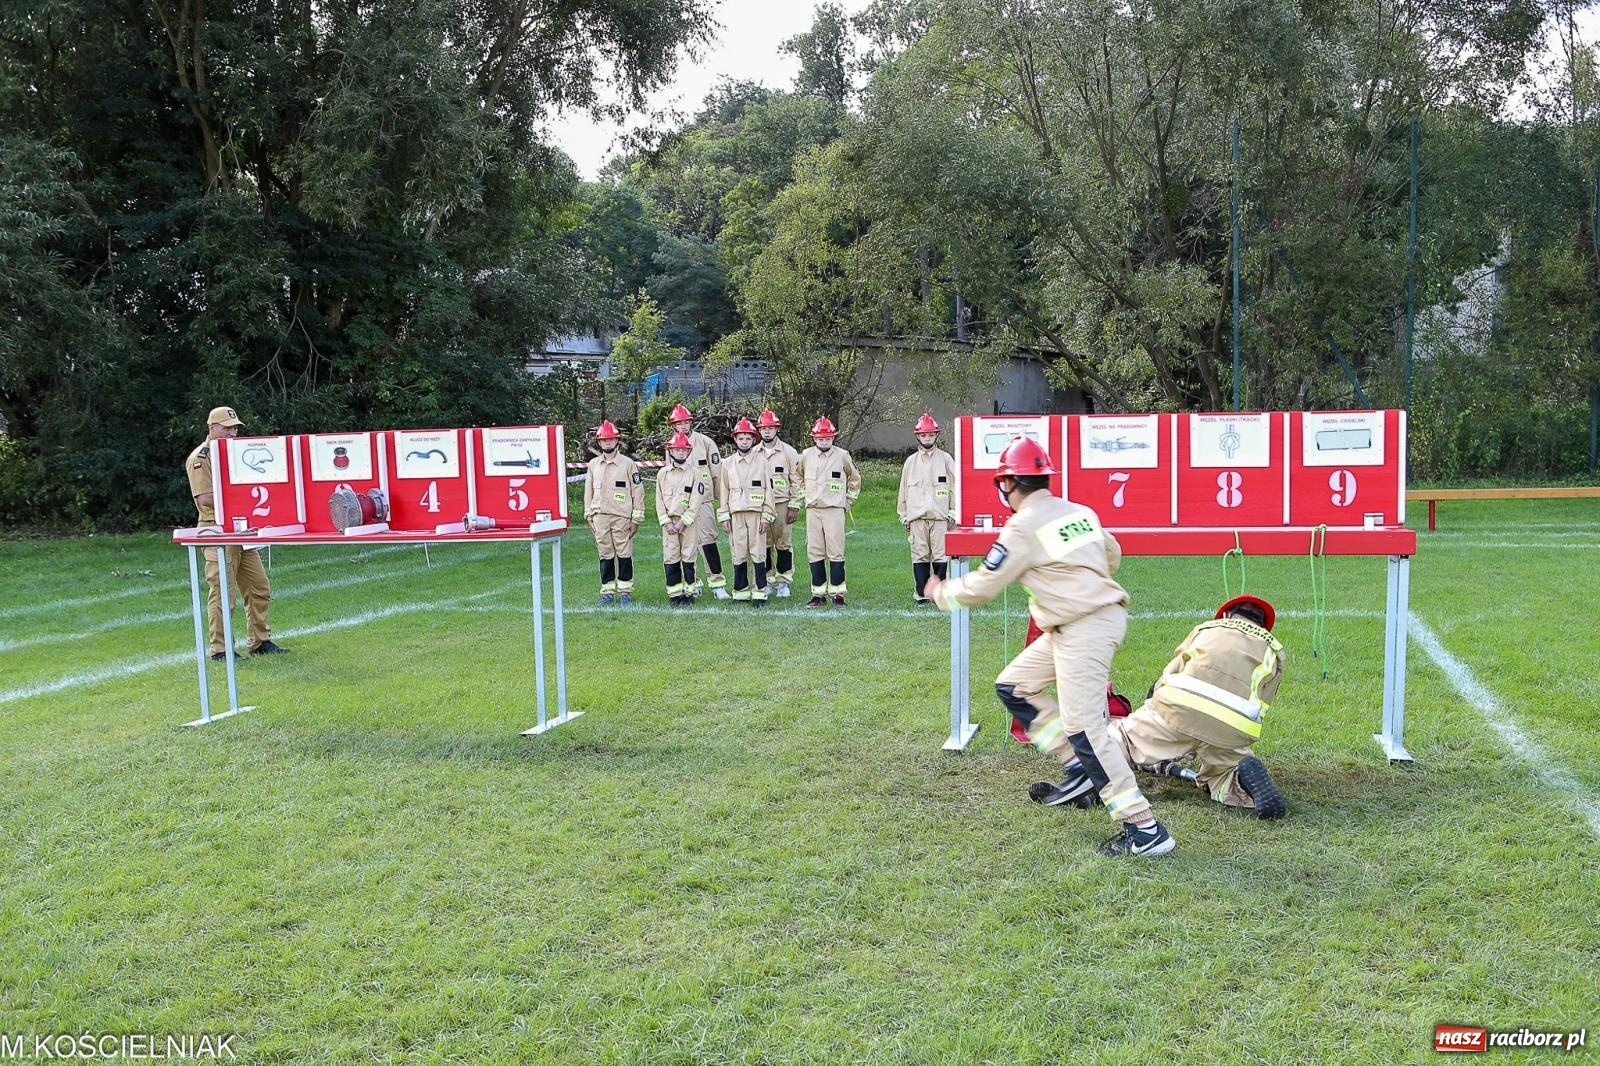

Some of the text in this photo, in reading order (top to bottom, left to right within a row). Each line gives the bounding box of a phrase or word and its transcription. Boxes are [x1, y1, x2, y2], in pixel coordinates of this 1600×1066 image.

[250, 485, 271, 517] 2
[419, 480, 441, 513] 4
[507, 478, 529, 511] 5
[1108, 472, 1131, 508] 7
[1216, 471, 1243, 508] 8
[1328, 469, 1357, 507] 9
